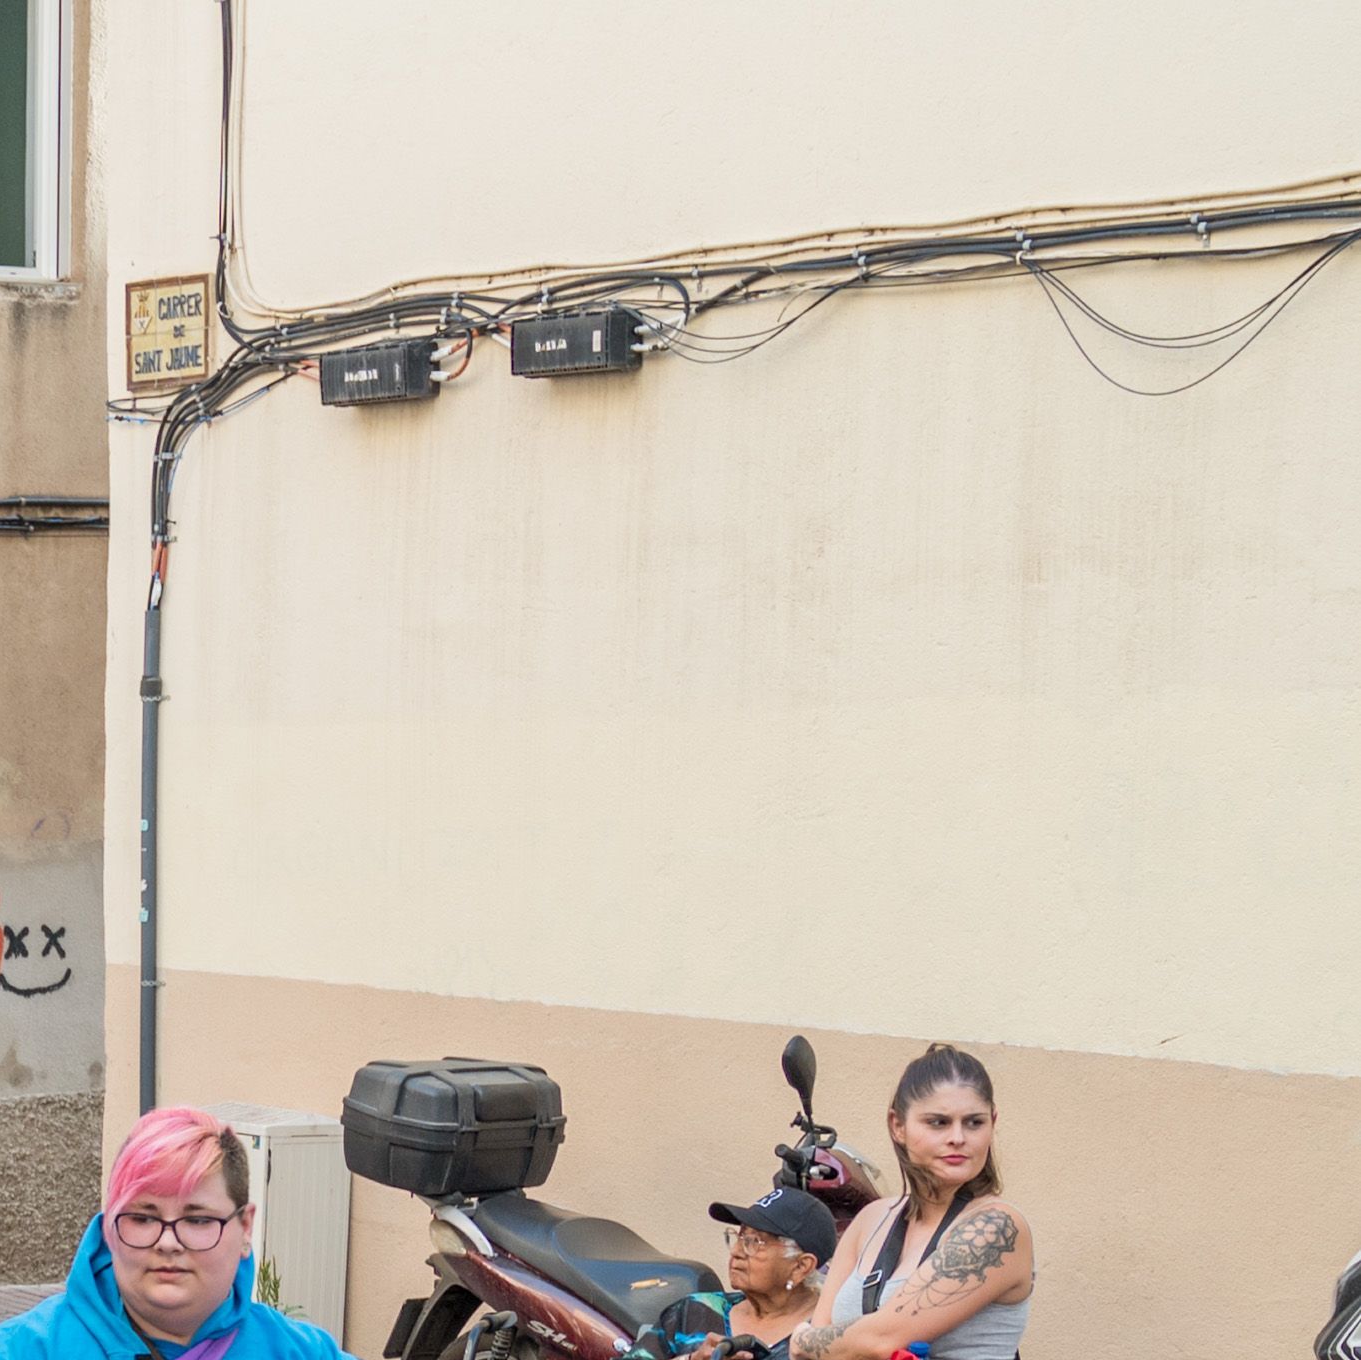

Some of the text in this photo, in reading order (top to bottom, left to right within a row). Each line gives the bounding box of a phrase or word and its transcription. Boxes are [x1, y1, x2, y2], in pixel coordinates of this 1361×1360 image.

[158, 293, 203, 321] CARRER
[134, 344, 203, 374] SANT JAUME
